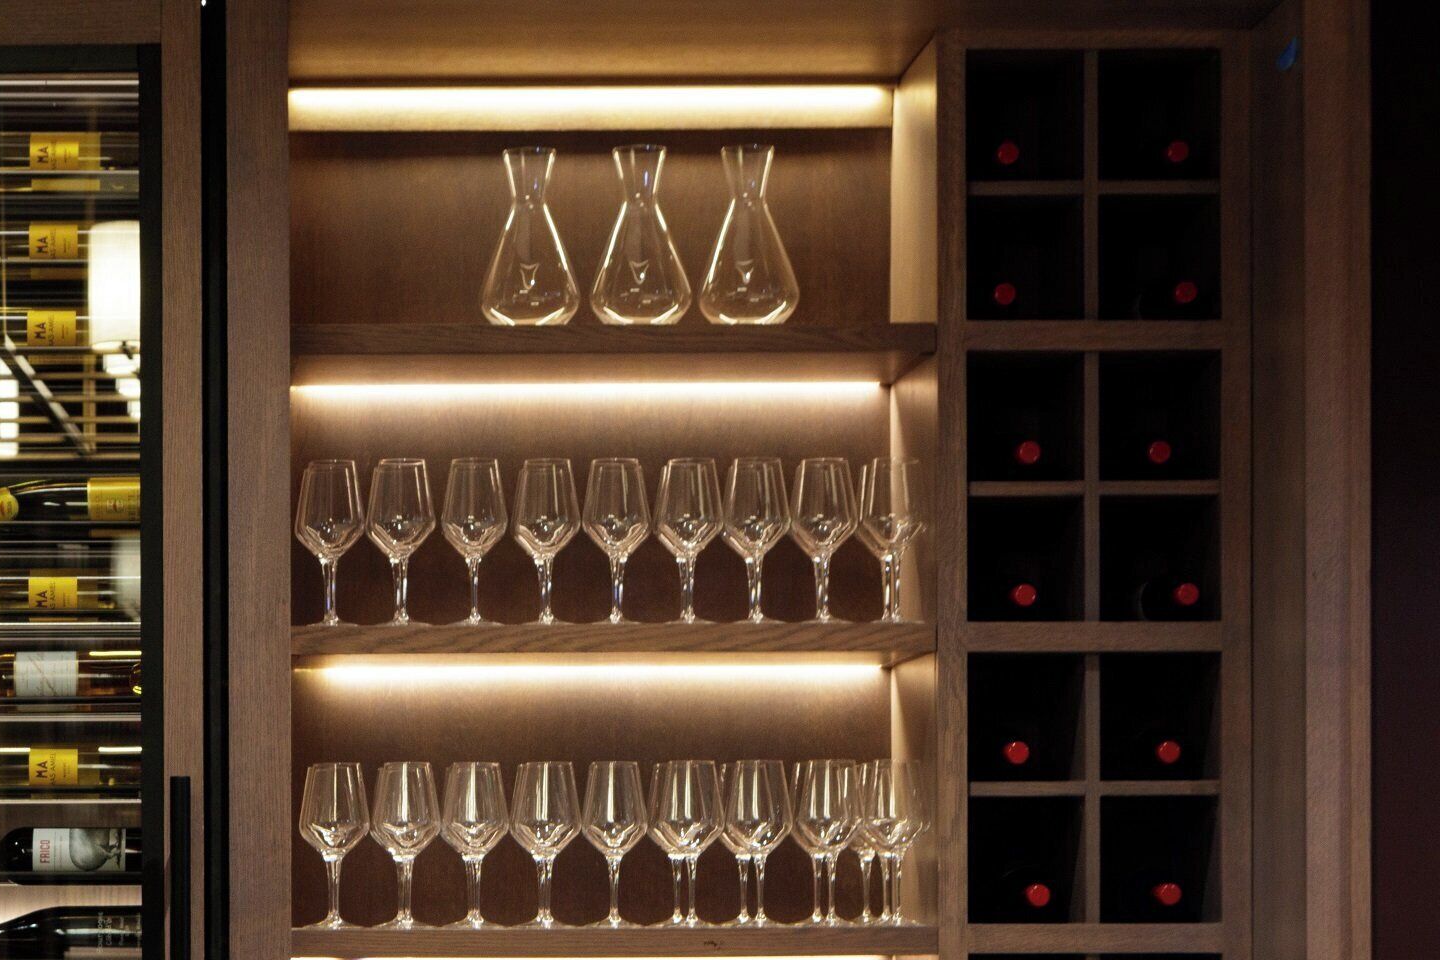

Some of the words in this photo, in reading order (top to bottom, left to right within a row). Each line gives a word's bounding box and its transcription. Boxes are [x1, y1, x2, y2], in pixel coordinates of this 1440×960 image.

[36, 145, 49, 164] MA
[35, 236, 49, 254] MA
[34, 322, 47, 340] MA
[35, 590, 48, 609] MA
[35, 760, 48, 779] MA
[39, 839, 51, 864] FRICO
